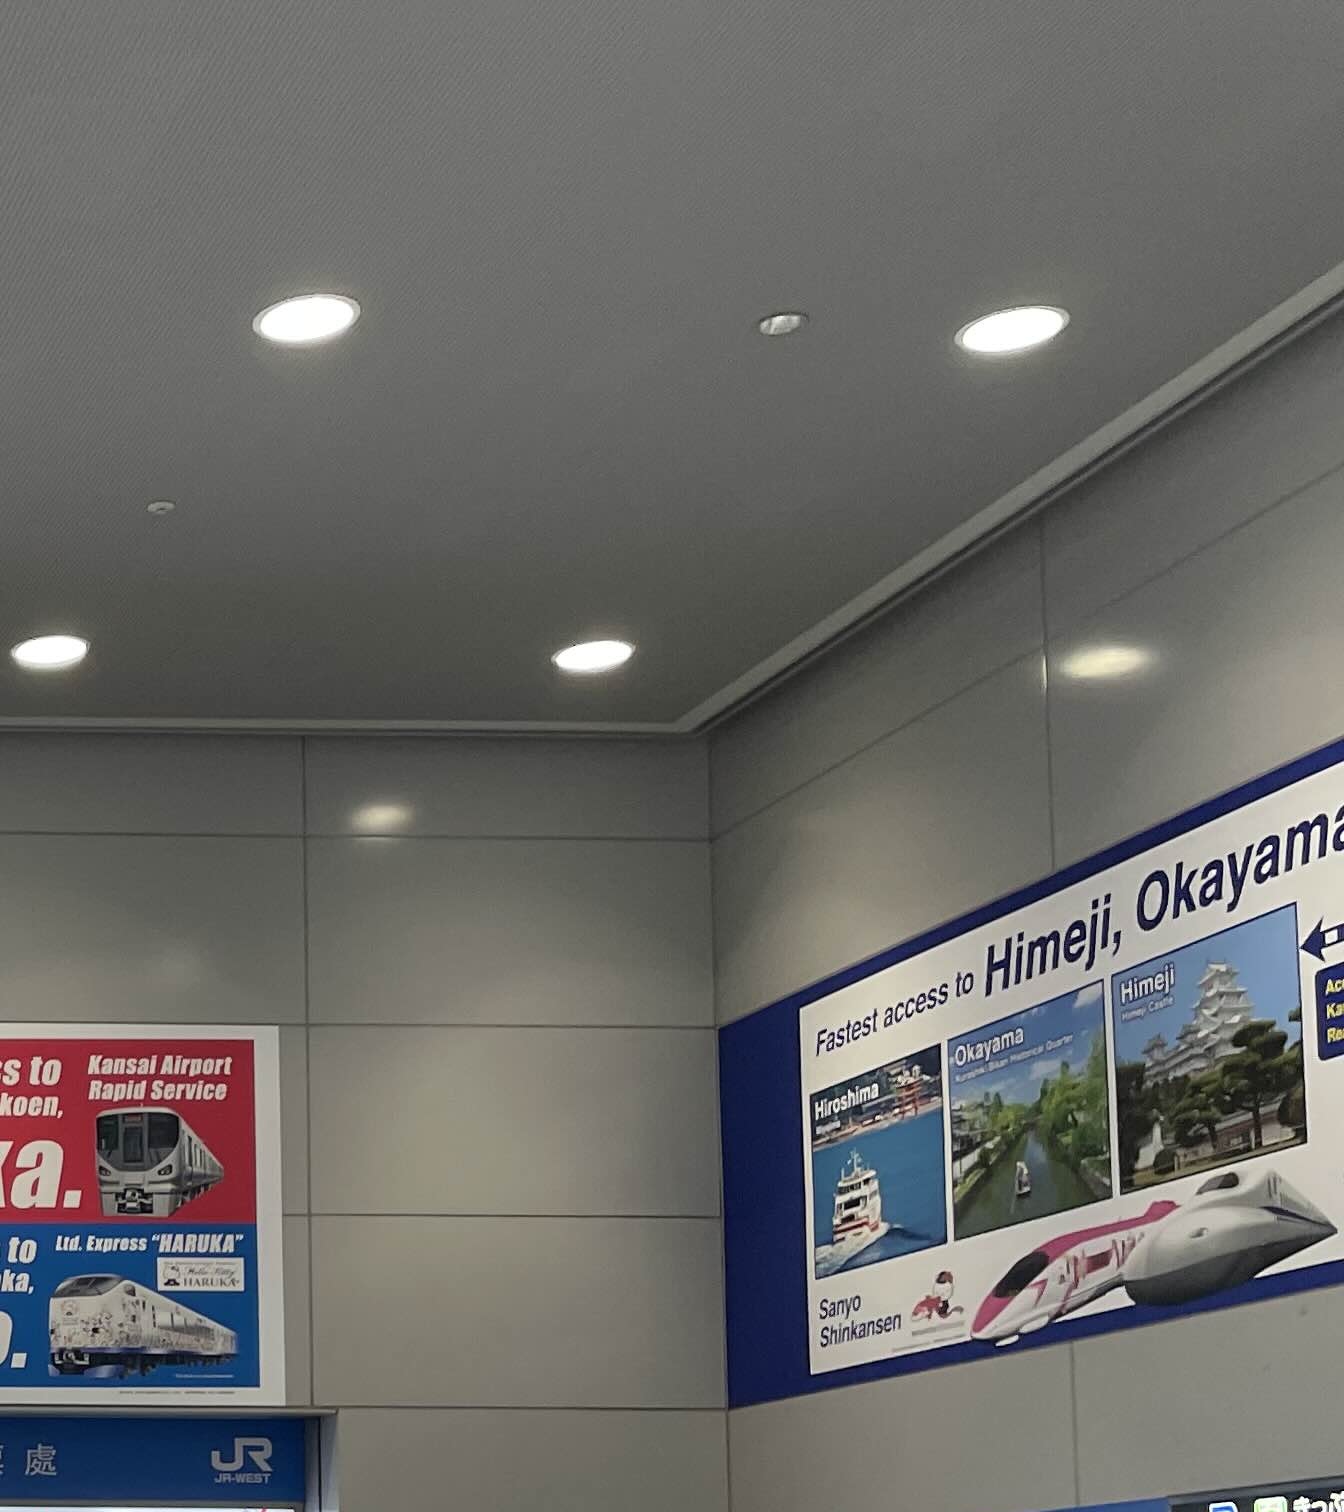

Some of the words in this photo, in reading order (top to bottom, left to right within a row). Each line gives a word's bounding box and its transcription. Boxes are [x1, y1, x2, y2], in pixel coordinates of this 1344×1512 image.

[816, 1009, 878, 1056] Fastest
[883, 983, 949, 1028] access
[955, 972, 974, 997] to
[985, 893, 1122, 997] Himeji,
[1120, 962, 1175, 1006] Himeji
[954, 1027, 1024, 1067] Okayama
[29, 1057, 62, 1086] to
[88, 1055, 157, 1075] Kansai
[160, 1055, 233, 1077] Airport
[88, 1080, 147, 1102] Rapid
[150, 1080, 228, 1100] Service
[814, 1082, 879, 1121] Hiroshima
[7, 1237, 38, 1264] to
[56, 1235, 83, 1251] Ltd.
[86, 1236, 147, 1252] Express
[184, 1277, 239, 1288] HARUKA
[819, 1296, 862, 1320] Sanyo
[820, 1314, 902, 1348] Shinkansen
[211, 1437, 273, 1472] JR
[215, 1473, 270, 1483] JR-WEST
